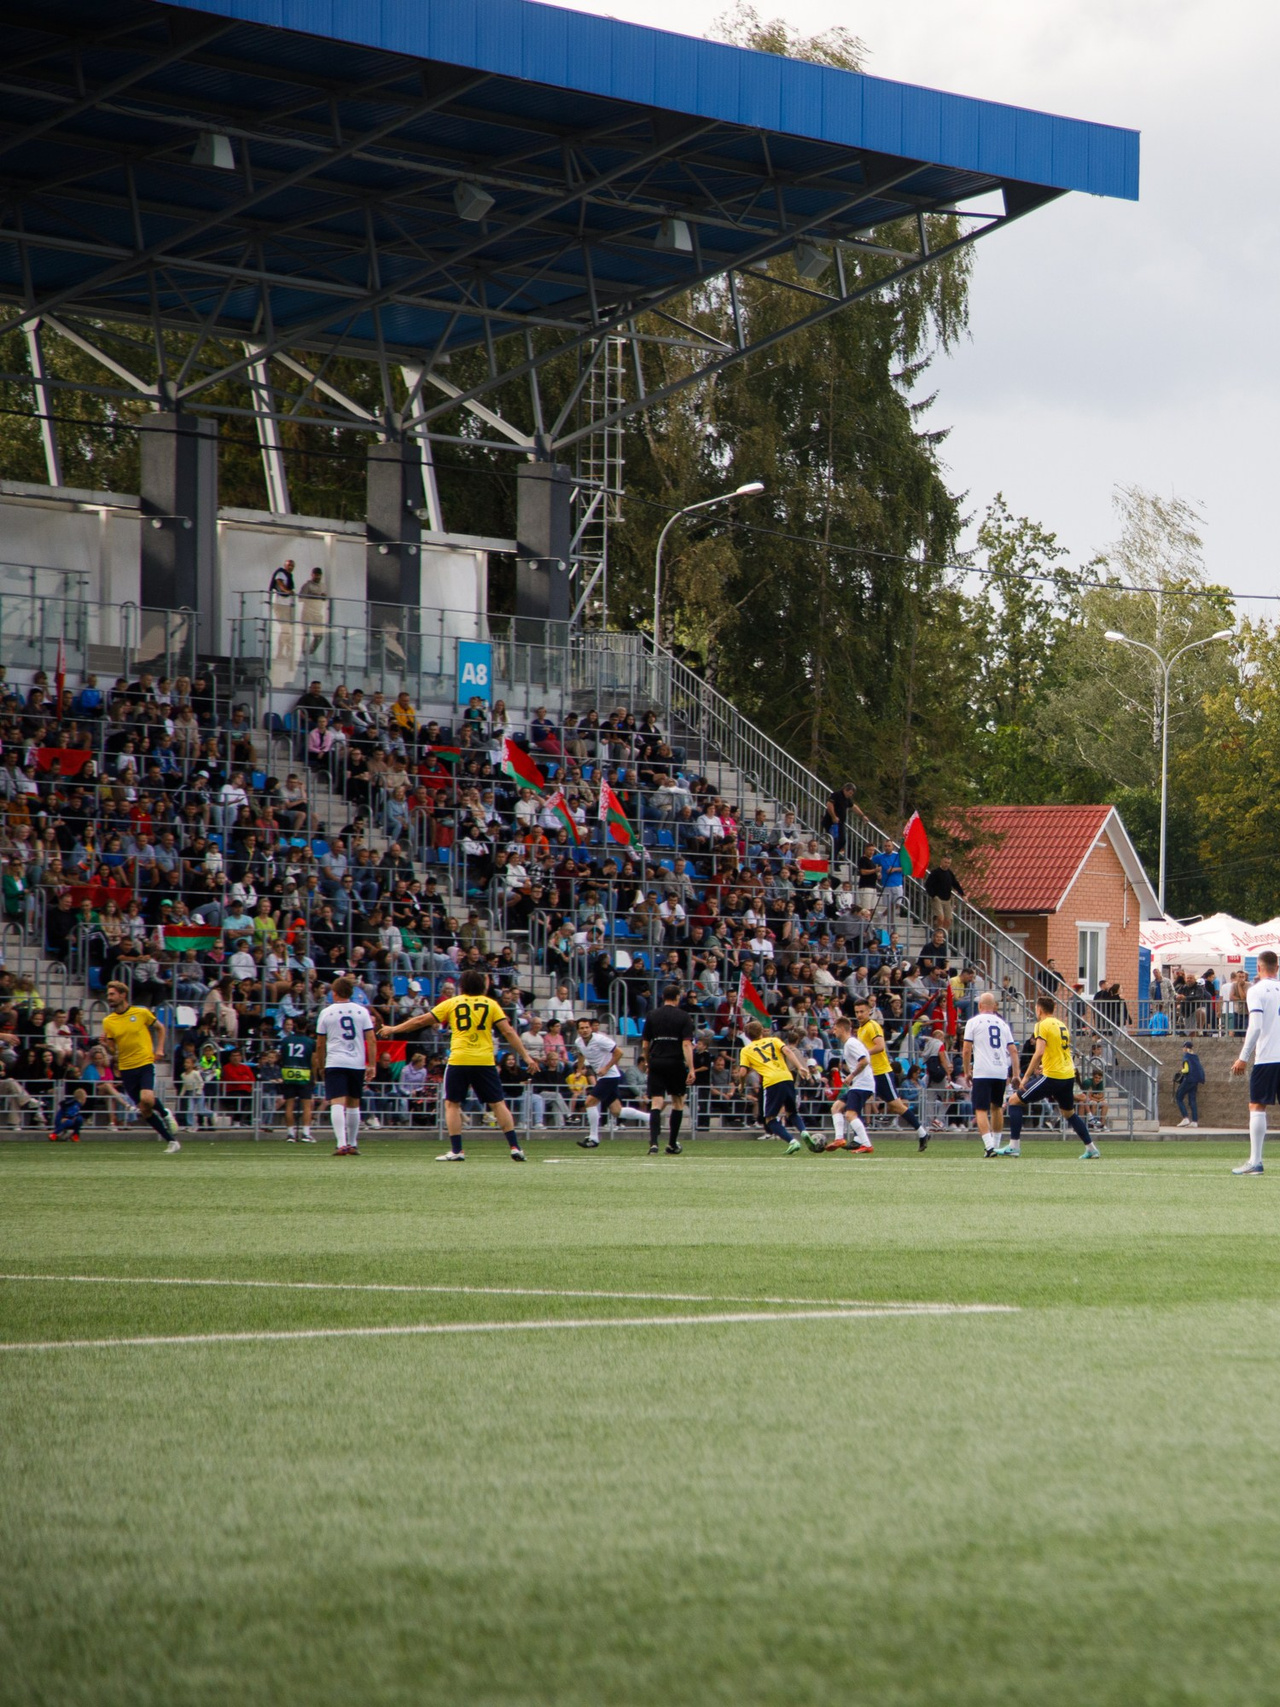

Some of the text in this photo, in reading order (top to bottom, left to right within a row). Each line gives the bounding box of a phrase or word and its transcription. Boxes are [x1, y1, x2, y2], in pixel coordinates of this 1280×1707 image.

[461, 662, 488, 686] A8
[340, 1016, 356, 1040] 9
[455, 1003, 489, 1031] 87
[988, 1025, 1001, 1049] 8
[1059, 1027, 1069, 1050] 5
[287, 1043, 305, 1058] 12
[753, 1042, 778, 1063] 17
